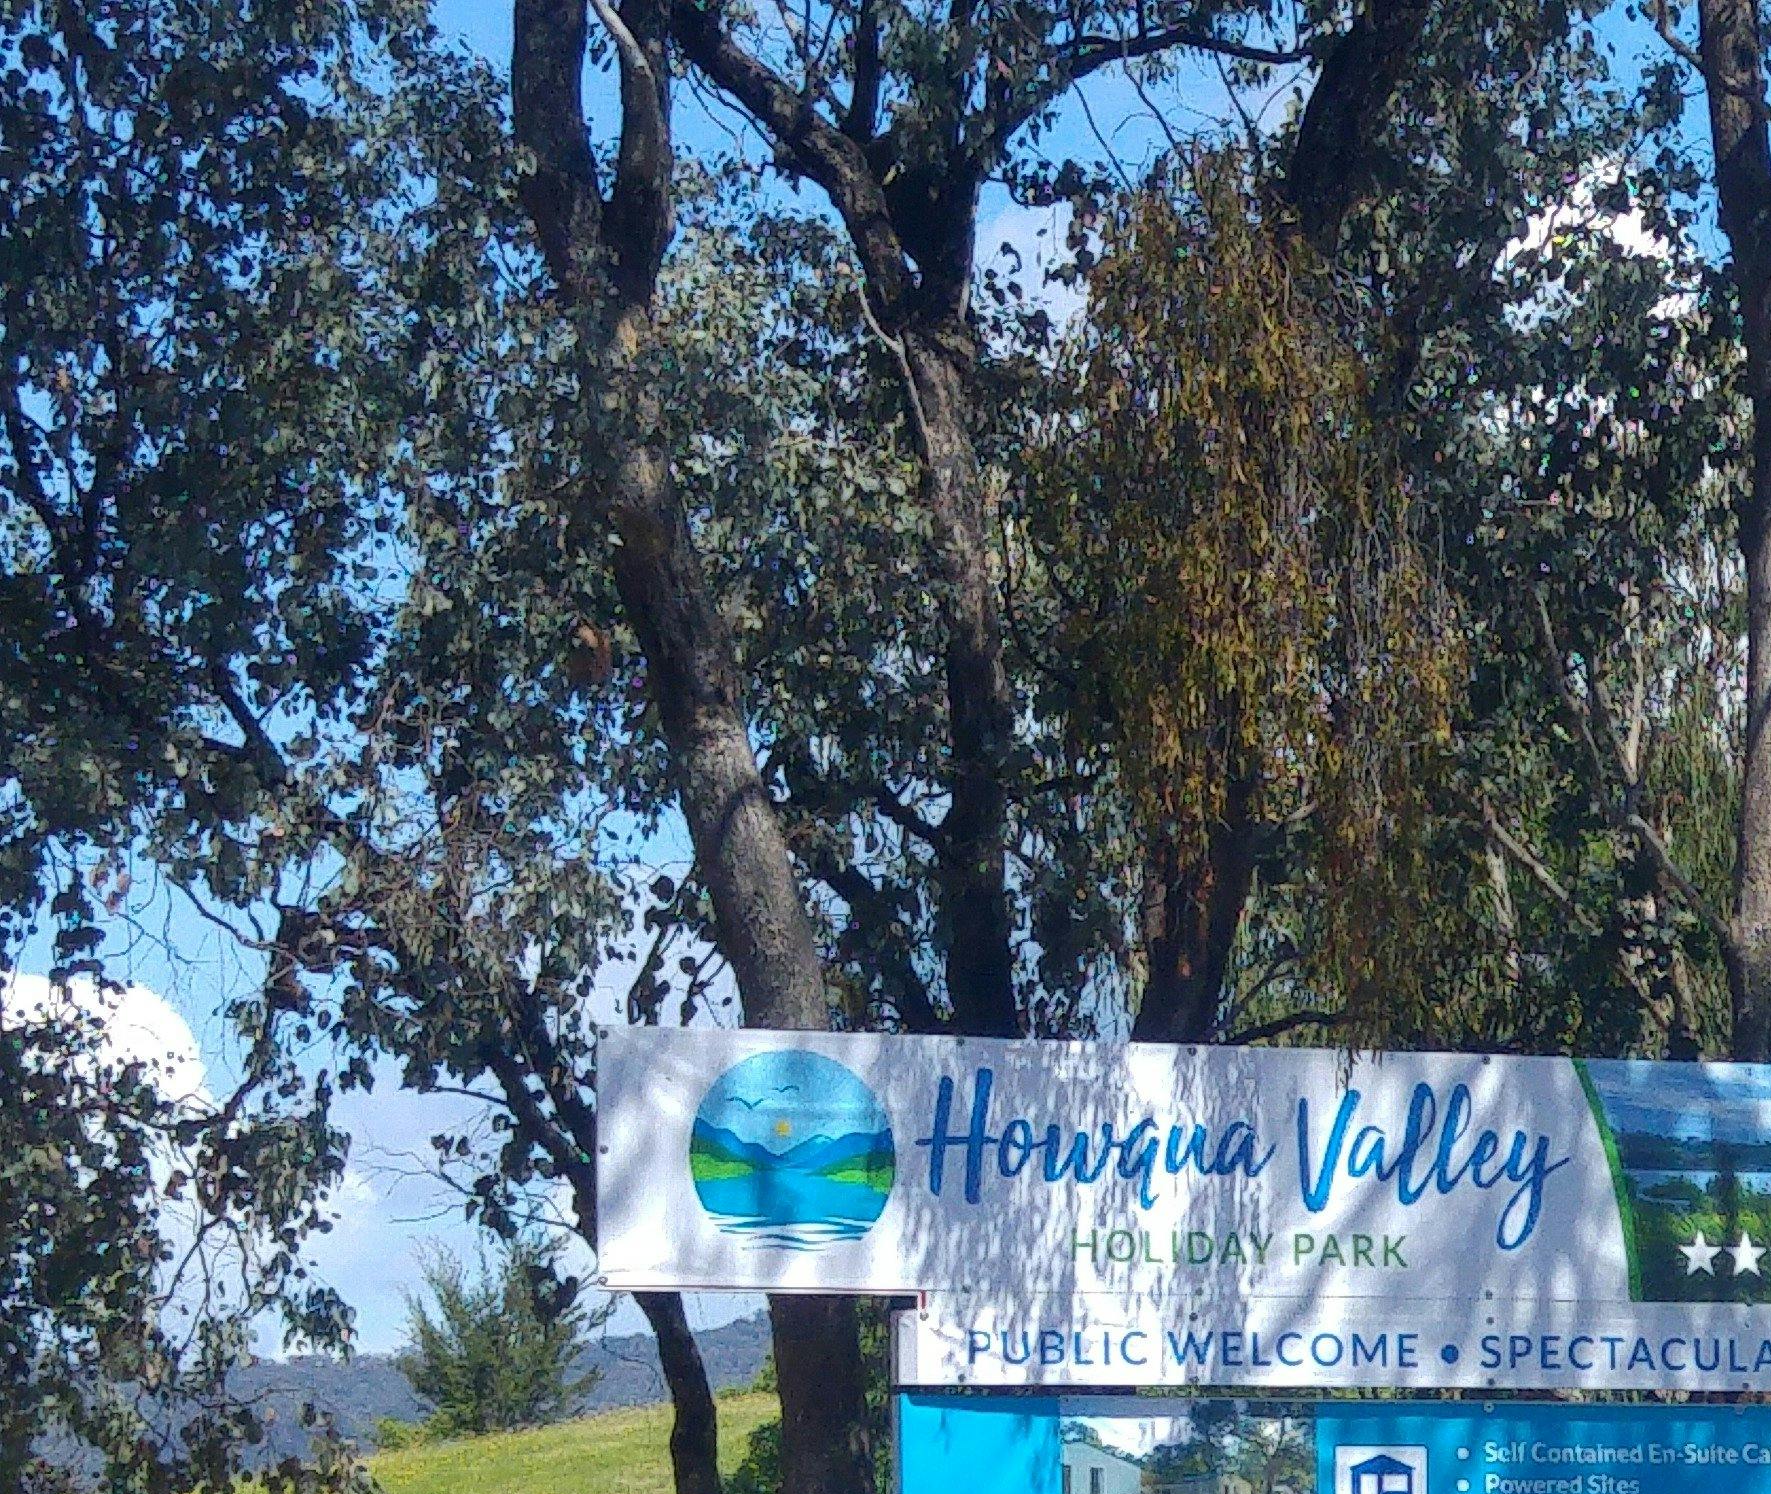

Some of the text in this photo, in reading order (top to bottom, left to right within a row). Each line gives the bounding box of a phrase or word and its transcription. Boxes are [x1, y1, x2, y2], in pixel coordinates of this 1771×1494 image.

[915, 1067, 1571, 1251] Howqua Valley
[1071, 1227, 1408, 1268] HOLIDAY PARK
[969, 1330, 1147, 1367] PUBLIC
[1166, 1331, 1420, 1369] WELCOME
[1484, 1442, 1524, 1464] Self
[1531, 1442, 1643, 1464] Contained
[1648, 1443, 1738, 1465] En-Suite
[1485, 1473, 1582, 1494] Powered
